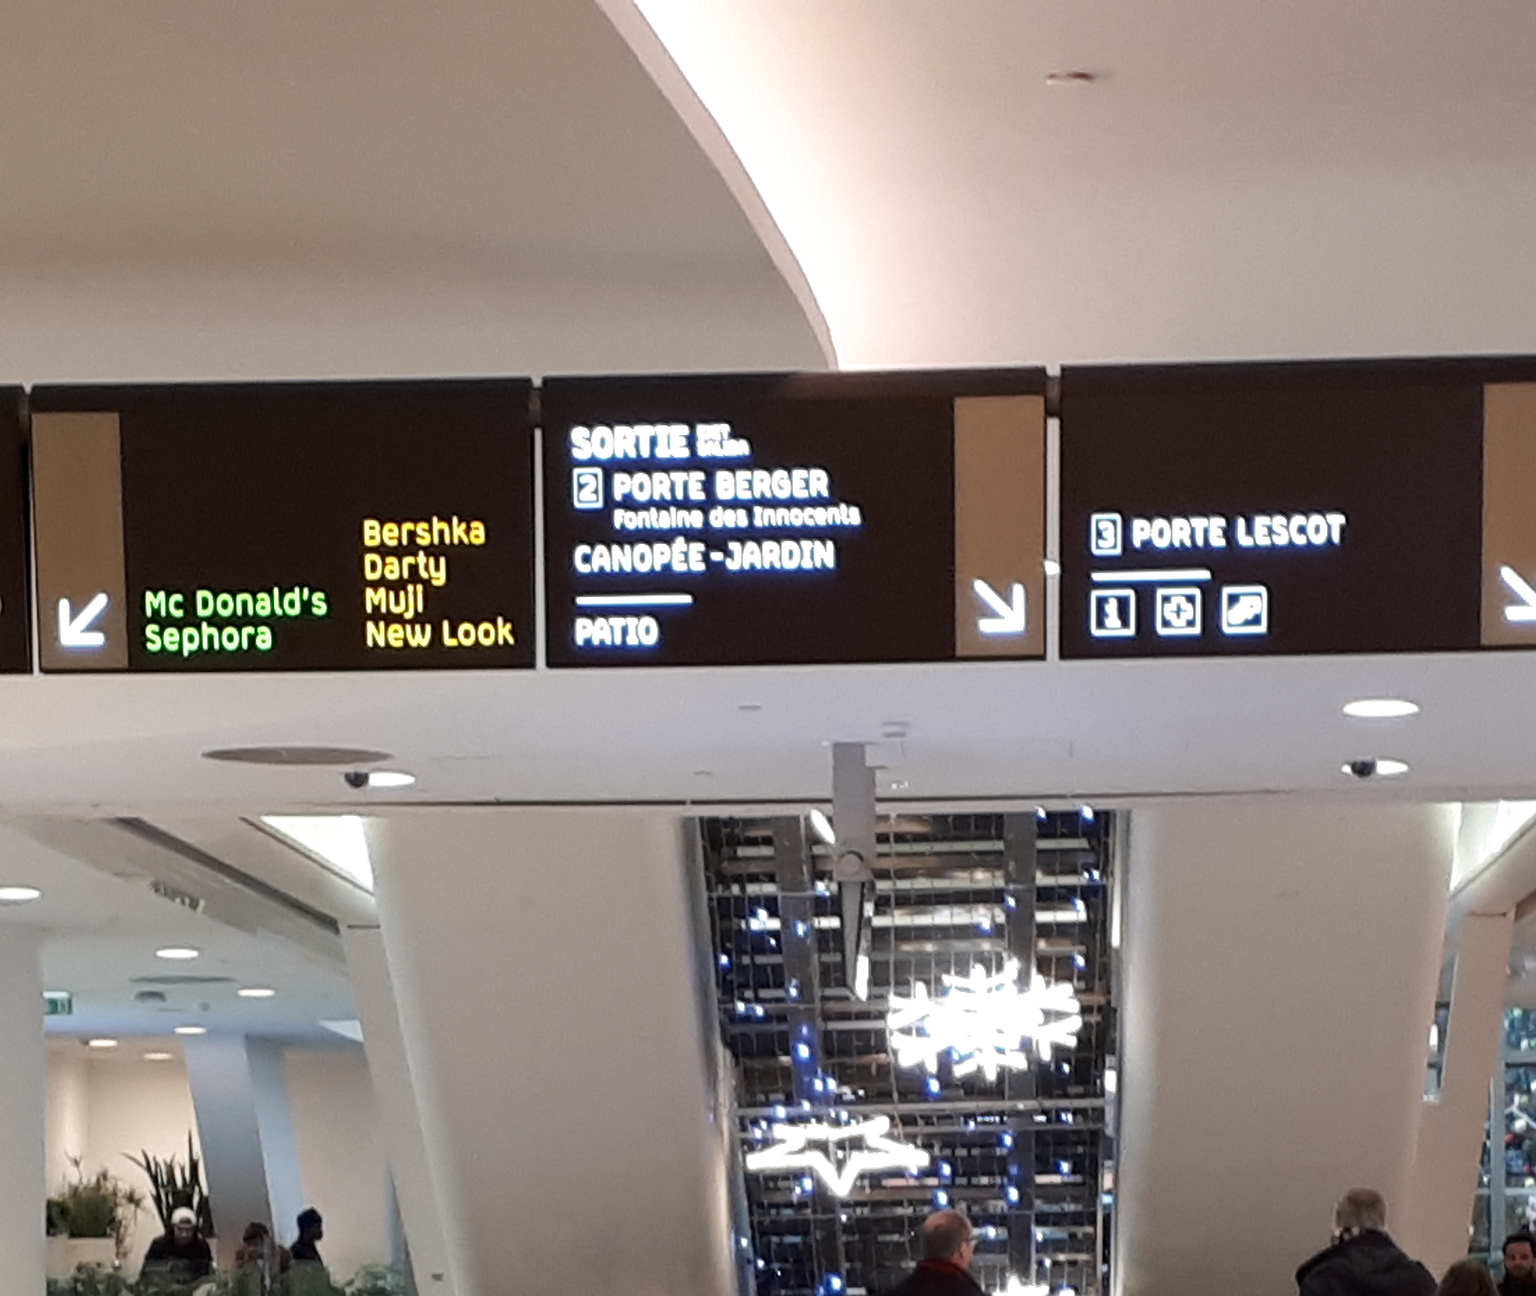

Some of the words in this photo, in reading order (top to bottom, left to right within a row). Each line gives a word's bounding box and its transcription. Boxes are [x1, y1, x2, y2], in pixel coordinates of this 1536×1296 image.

[570, 423, 691, 461] SORTIE
[578, 472, 599, 502] 2
[612, 470, 706, 503] PORTE
[714, 468, 829, 501] BERGER
[363, 515, 486, 547] Bershka
[613, 505, 705, 531] Fontaine
[708, 505, 749, 529] des
[752, 502, 862, 528] Innocents
[1096, 518, 1117, 550] 3
[1131, 516, 1227, 549] PORTE
[1236, 513, 1346, 548] LESCOT
[364, 550, 447, 589] Darty
[145, 590, 184, 618] Mc
[195, 586, 328, 618] Donald's
[365, 586, 424, 619] Muji
[145, 621, 273, 658] Sephora
[366, 617, 432, 648] New
[442, 616, 515, 647] Look
[574, 615, 659, 646] PATIO
